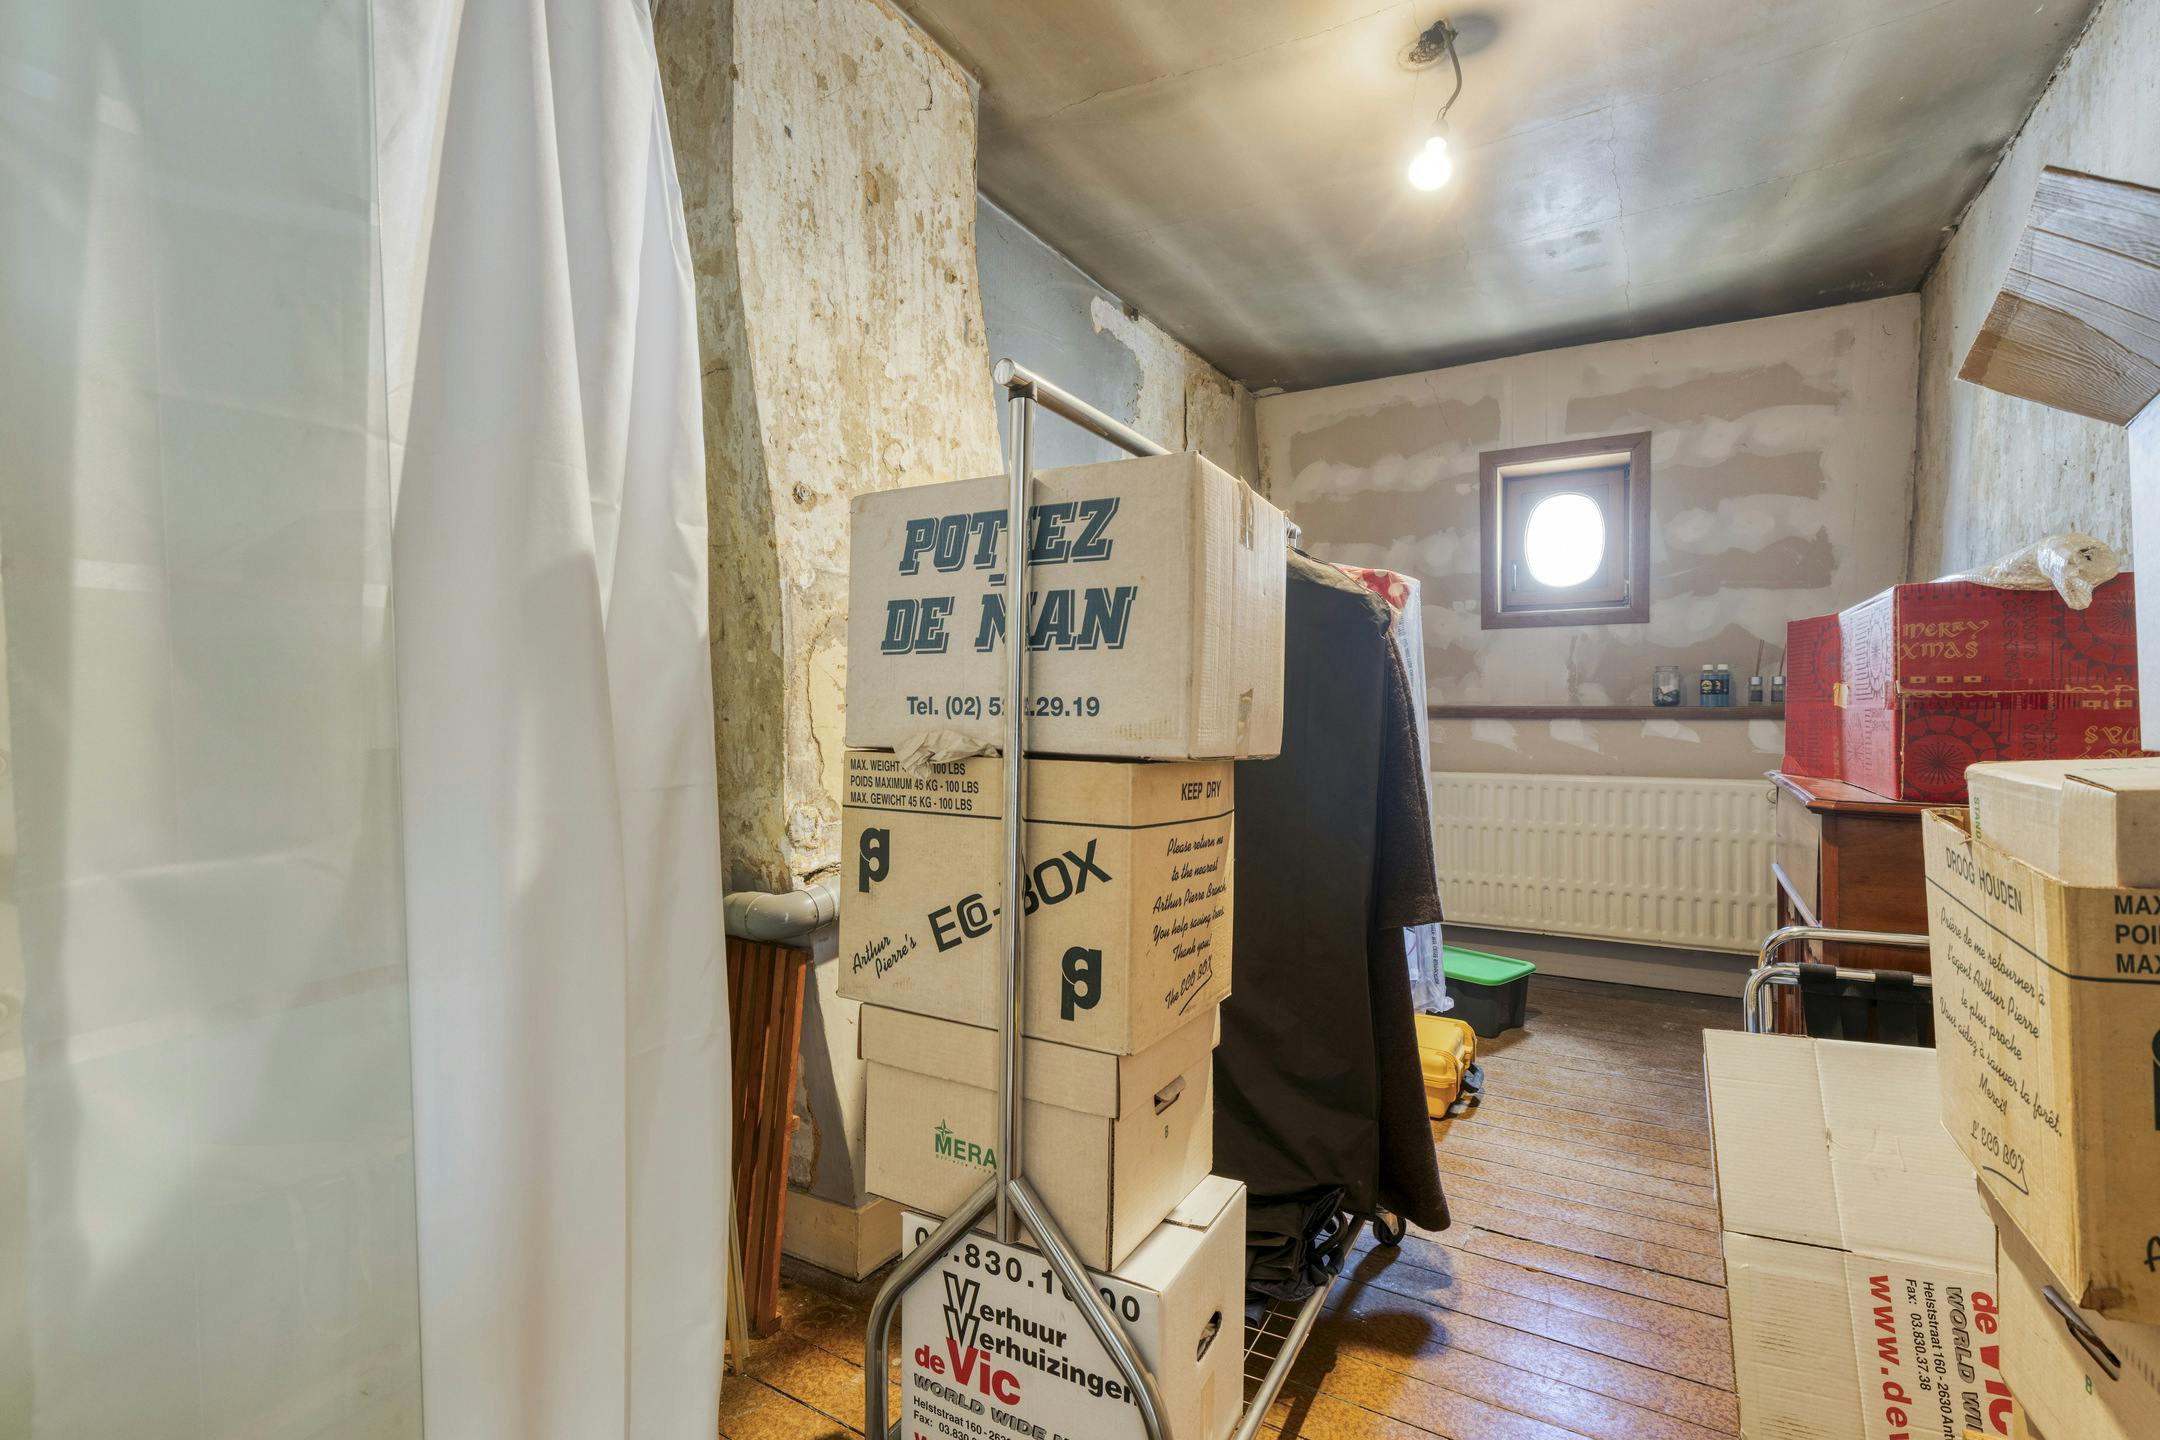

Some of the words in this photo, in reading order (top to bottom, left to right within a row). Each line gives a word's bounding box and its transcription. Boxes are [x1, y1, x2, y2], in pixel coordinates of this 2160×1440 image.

[899, 497, 1120, 576] POTEZ
[881, 596, 955, 655] DE
[906, 696, 939, 715] Tel.
[945, 696, 982, 719] (02)
[988, 696, 1100, 717] 5.29.19
[850, 759, 868, 770] MAX.
[871, 760, 900, 771] WEIGHT
[948, 763, 965, 775] LBS
[850, 775, 873, 788] POIDS
[875, 777, 912, 790] MAXIMUM
[914, 779, 924, 791] 45
[926, 780, 938, 792] KG
[945, 781, 959, 792] 100
[962, 781, 979, 794] LBS
[850, 792, 868, 804] MAX.
[870, 794, 906, 806] GEWICHT
[908, 796, 917, 807] 45
[920, 796, 931, 808] KG
[939, 798, 953, 809] 100
[955, 799, 972, 811] LBS
[1181, 782, 1203, 801] KEEP
[1206, 780, 1222, 799] DRY
[1167, 837, 1192, 857] Please
[1171, 865, 1180, 882] to
[1181, 862, 1193, 880] the
[1946, 846, 1976, 886] DROOG
[1978, 867, 2023, 915] HOUDEN
[1152, 892, 1182, 914] Arthur
[1183, 888, 1205, 907] Pierre
[1153, 924, 1170, 947] You
[1171, 918, 1188, 938] help
[1172, 937, 1196, 962] Thank
[2115, 924, 2160, 945] POI
[852, 935, 891, 975] Arthur
[874, 934, 917, 979] Pierre's
[1963, 926, 1973, 948] de
[1974, 944, 1986, 960] me
[1987, 950, 2035, 998] retourner
[2038, 985, 2046, 1006] à
[1165, 988, 1180, 1009] The
[1973, 969, 2006, 1010] Arthur
[2007, 996, 2040, 1039] Pierre
[1961, 987, 1968, 1009] le
[1969, 1001, 1988, 1028] plus
[1989, 1025, 2023, 1061] proche
[1940, 996, 1957, 1028] Vous
[1986, 1052, 2018, 1093] sauver
[2020, 1079, 2031, 1105] la
[2033, 1092, 2063, 1138] forêt.
[1978, 1073, 2008, 1117] Merci!
[934, 1133, 998, 1171] MERA
[2002, 1143, 2025, 1175] BOX
[1905, 1278, 1918, 1305] Fax:
[942, 1270, 1068, 1349] Verhuur
[1922, 1281, 1943, 1350] Helststraat
[1910, 1312, 1932, 1391] 03.830.37.38
[1946, 1286, 1976, 1384] WORLD
[1869, 1275, 1913, 1440] www.de
[1933, 1352, 1947, 1374] 160
[913, 1372, 986, 1416] WORLD
[990, 1406, 1048, 1440] WIDE
[913, 1395, 964, 1428] Helststraat
[966, 1419, 983, 1436] 160
[1937, 1383, 1951, 1415] 2630
[913, 1410, 934, 1428] Fax:
[1941, 1415, 1956, 1440] Ant
